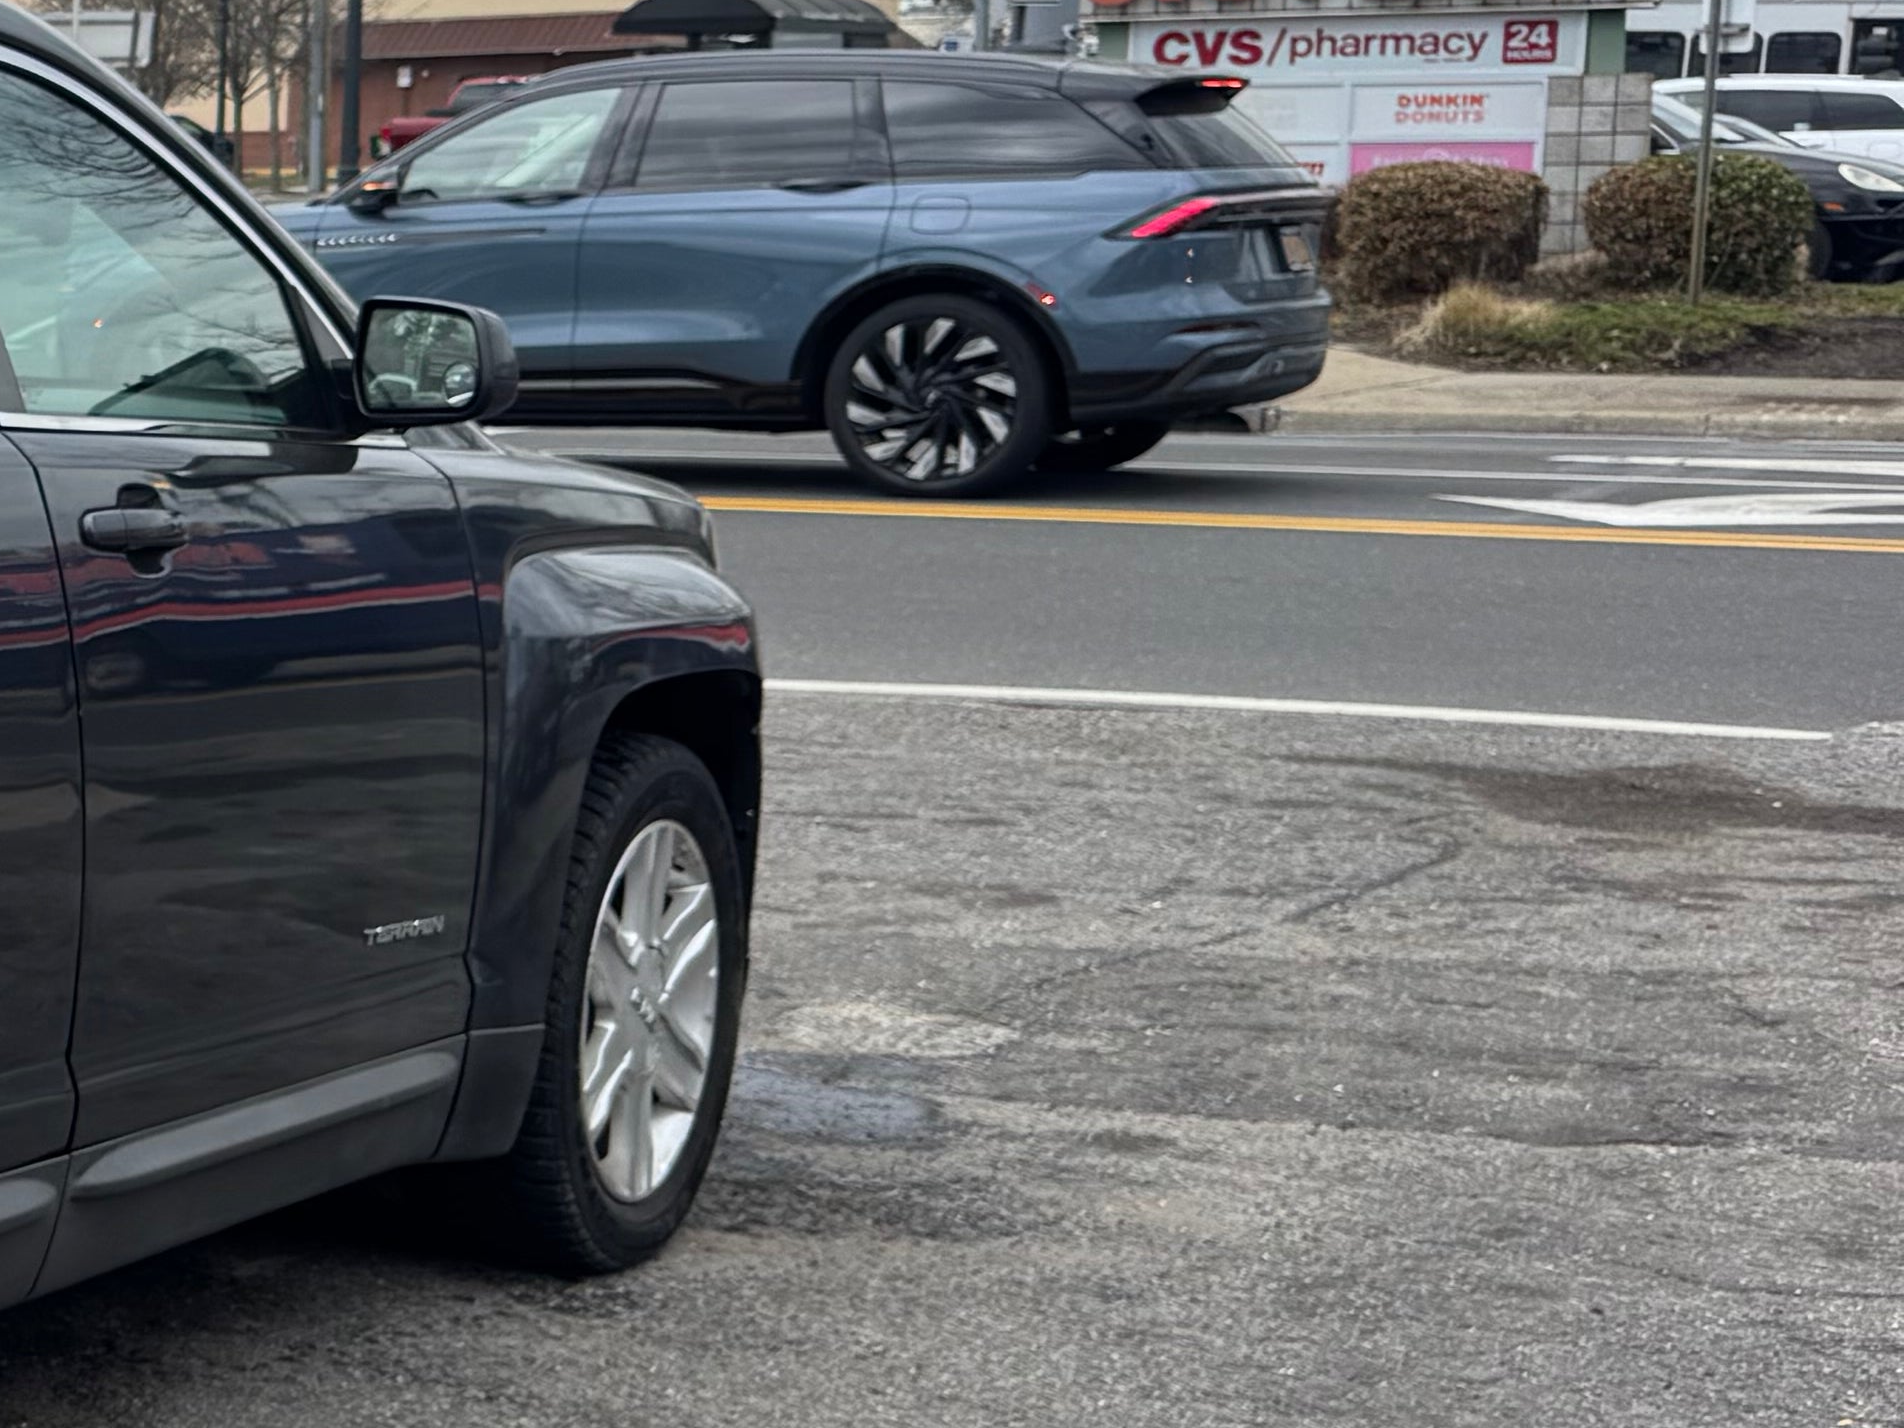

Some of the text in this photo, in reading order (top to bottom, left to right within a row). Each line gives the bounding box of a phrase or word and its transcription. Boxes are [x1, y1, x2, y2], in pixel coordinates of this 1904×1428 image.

[1152, 25, 1489, 67] CVS/pharmacy
[1508, 23, 1552, 48] 24
[1395, 110, 1485, 124] DONUTS
